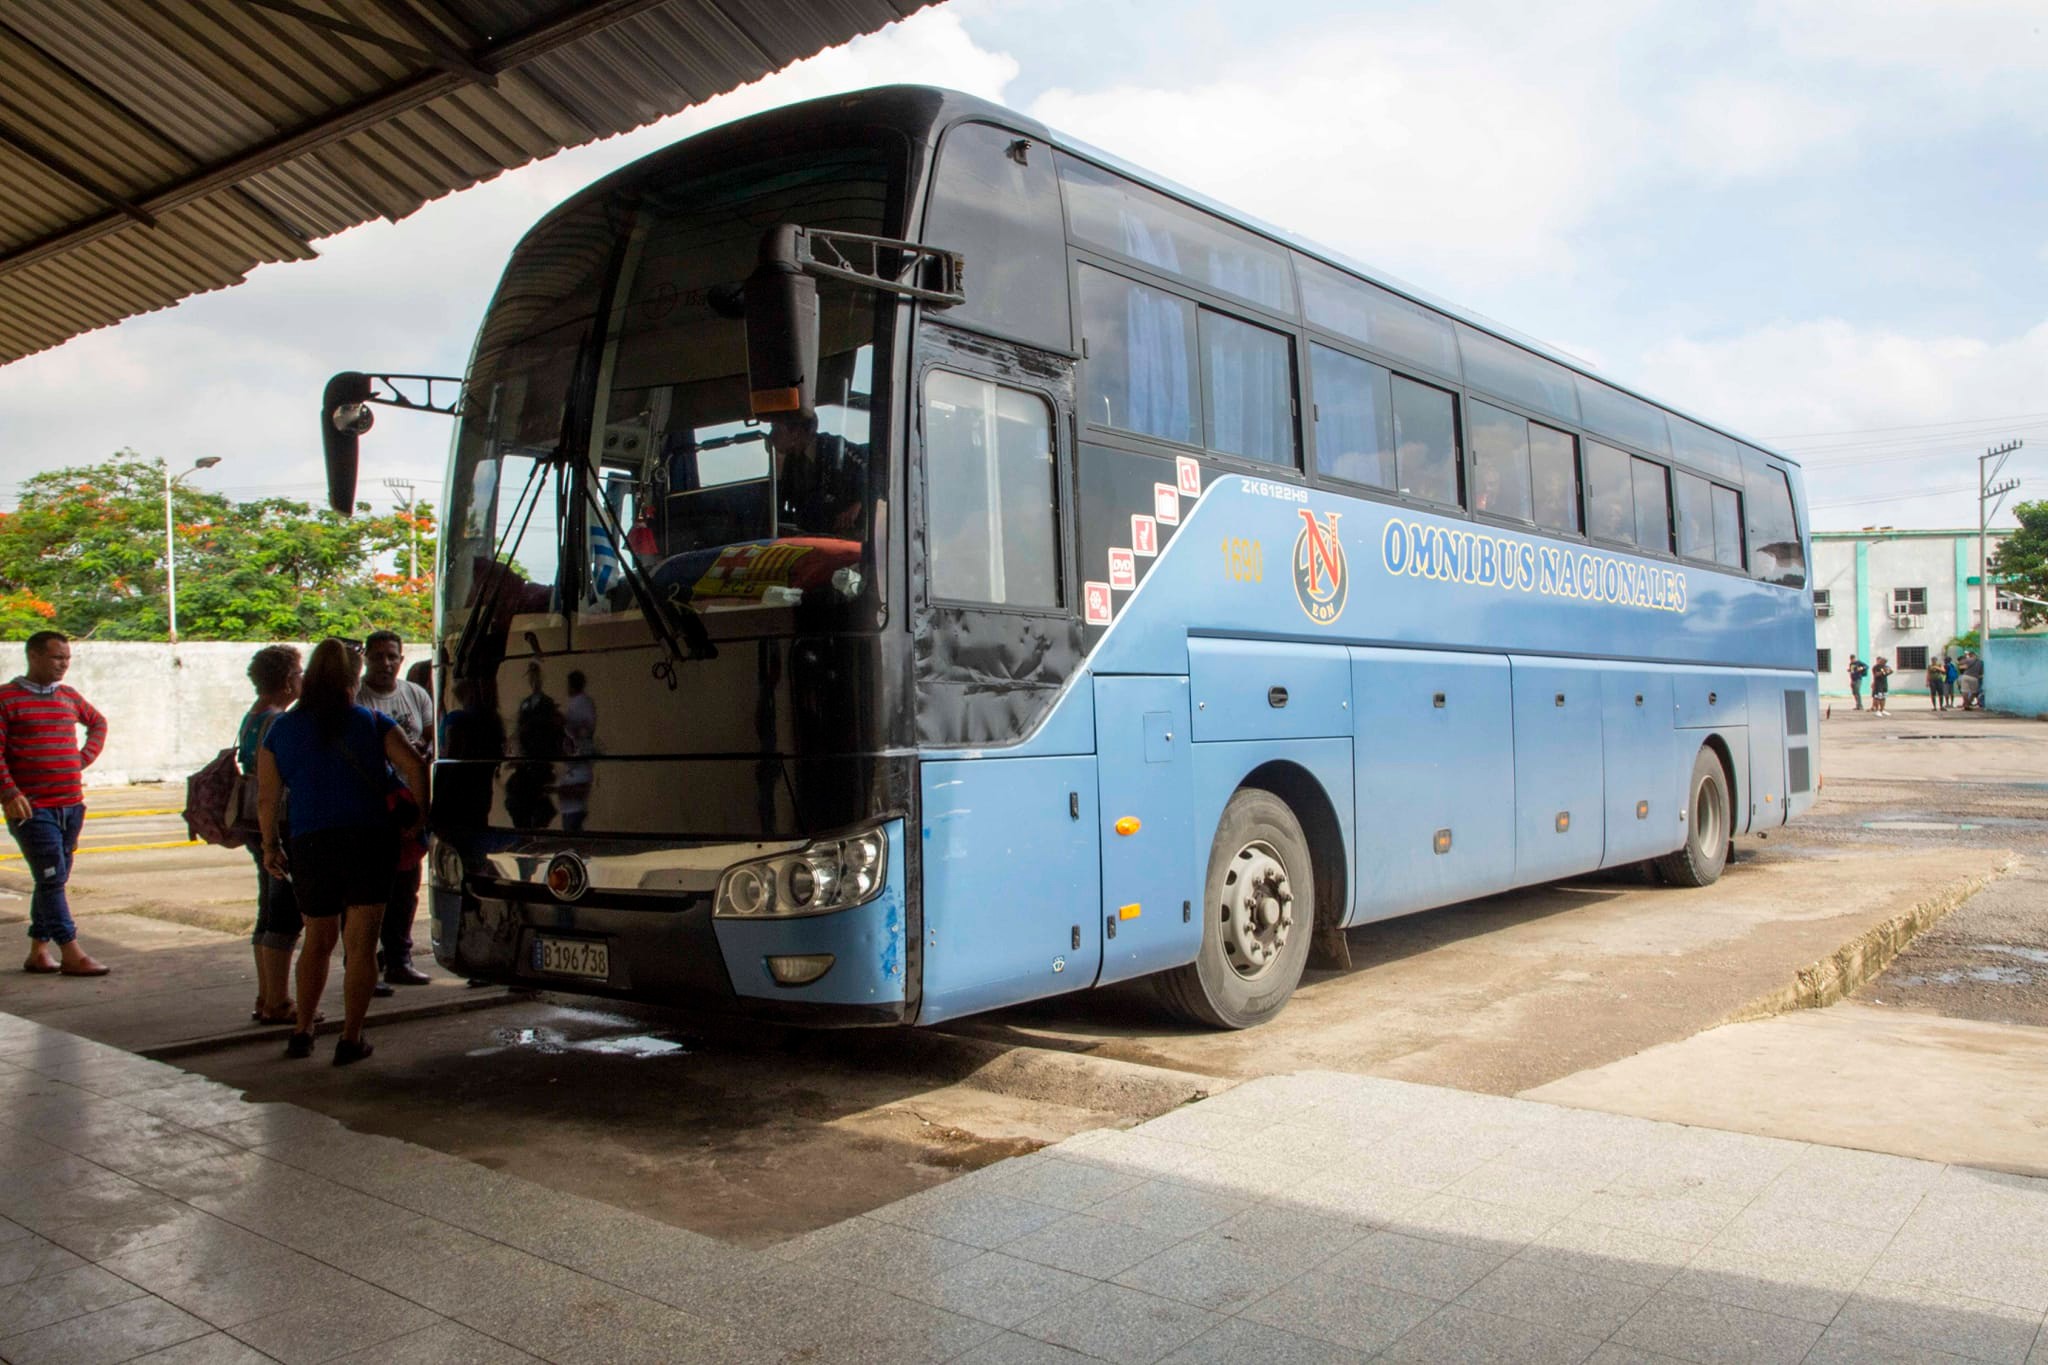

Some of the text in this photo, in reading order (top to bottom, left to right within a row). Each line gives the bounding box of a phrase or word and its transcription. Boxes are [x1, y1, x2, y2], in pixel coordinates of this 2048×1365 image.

[1240, 479, 1309, 503] ZK6122H9
[1221, 537, 1263, 582] 1690
[1382, 518, 1688, 614] OMNIBUS NACIONALES
[1312, 602, 1335, 619] EON
